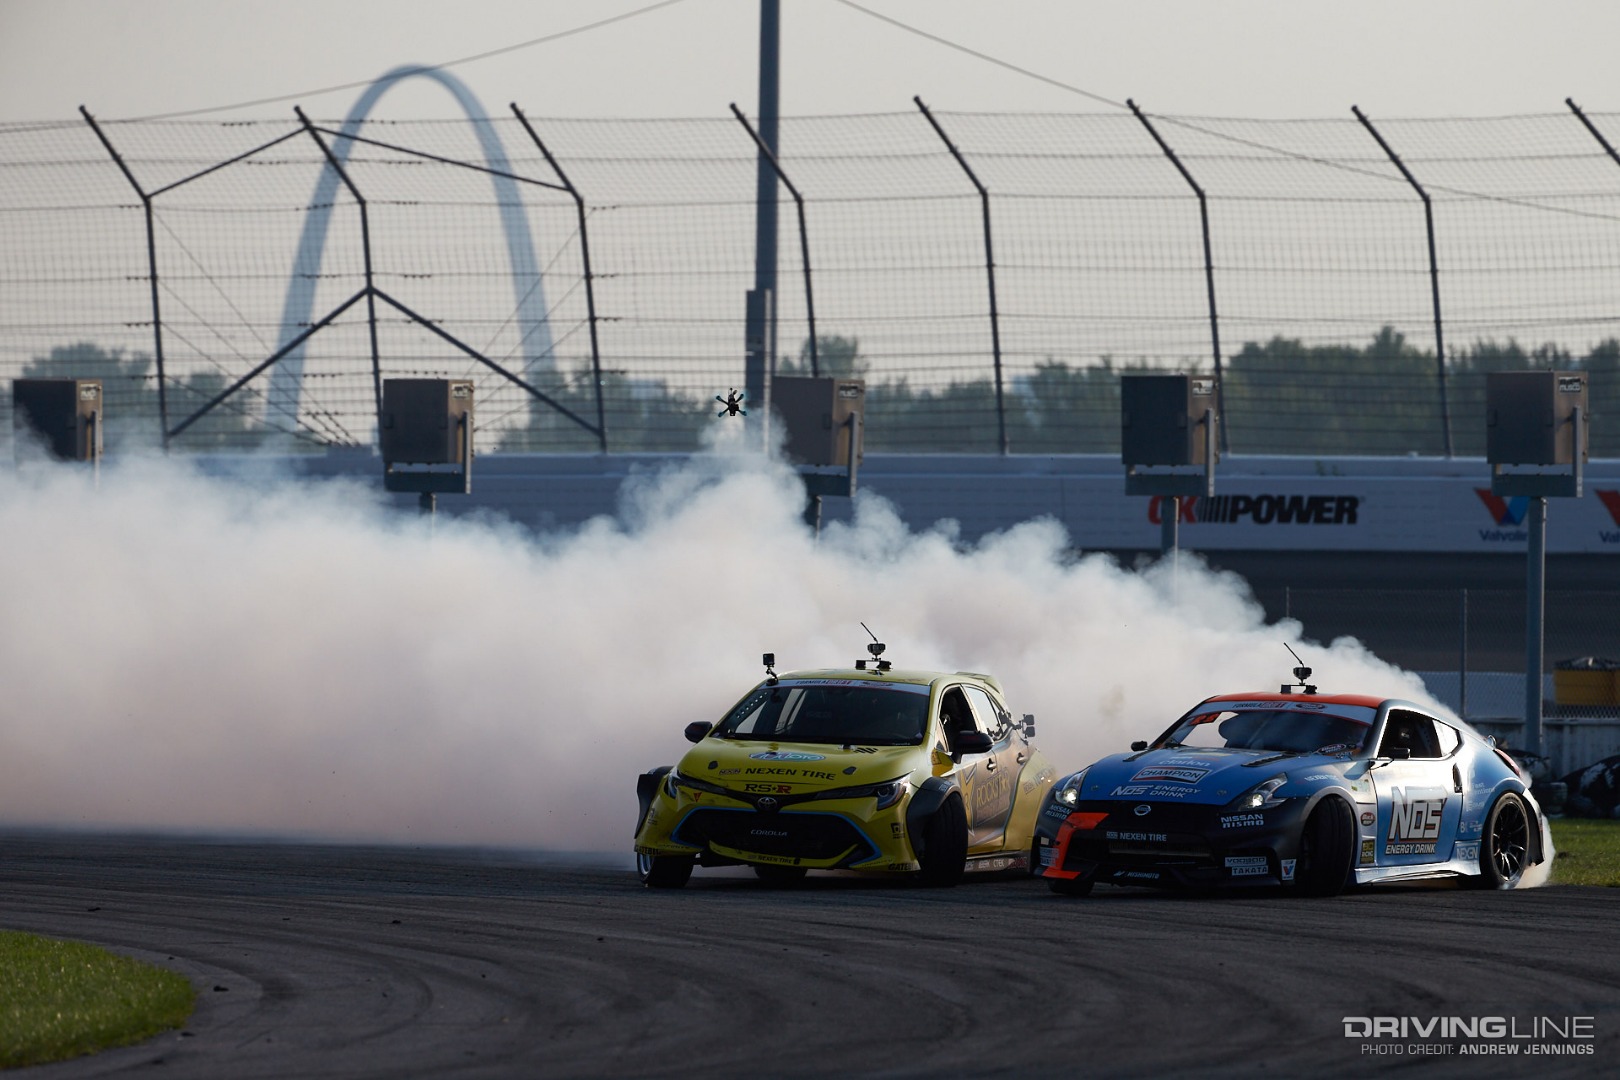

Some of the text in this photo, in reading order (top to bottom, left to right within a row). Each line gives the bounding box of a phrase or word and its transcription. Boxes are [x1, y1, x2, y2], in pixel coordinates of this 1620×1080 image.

[1229, 494, 1359, 526] POWER
[1479, 530, 1528, 542] Valvolin
[745, 767, 837, 781] NEXEN TIRE
[1140, 769, 1201, 779] CHAMPION
[1109, 784, 1203, 797] NOS ENERGY
[1149, 790, 1187, 799] DRINK
[1049, 804, 1073, 815] NISSAN
[1386, 785, 1447, 842] NOS
[1220, 814, 1264, 823] NISSAN
[1222, 819, 1265, 829] nismo
[750, 829, 788, 837] COROLLA
[1119, 832, 1147, 841] NEXEN
[1148, 833, 1168, 842] TIRE
[1385, 843, 1437, 855] ENERGY DRINK
[1232, 866, 1268, 875] TAKATA
